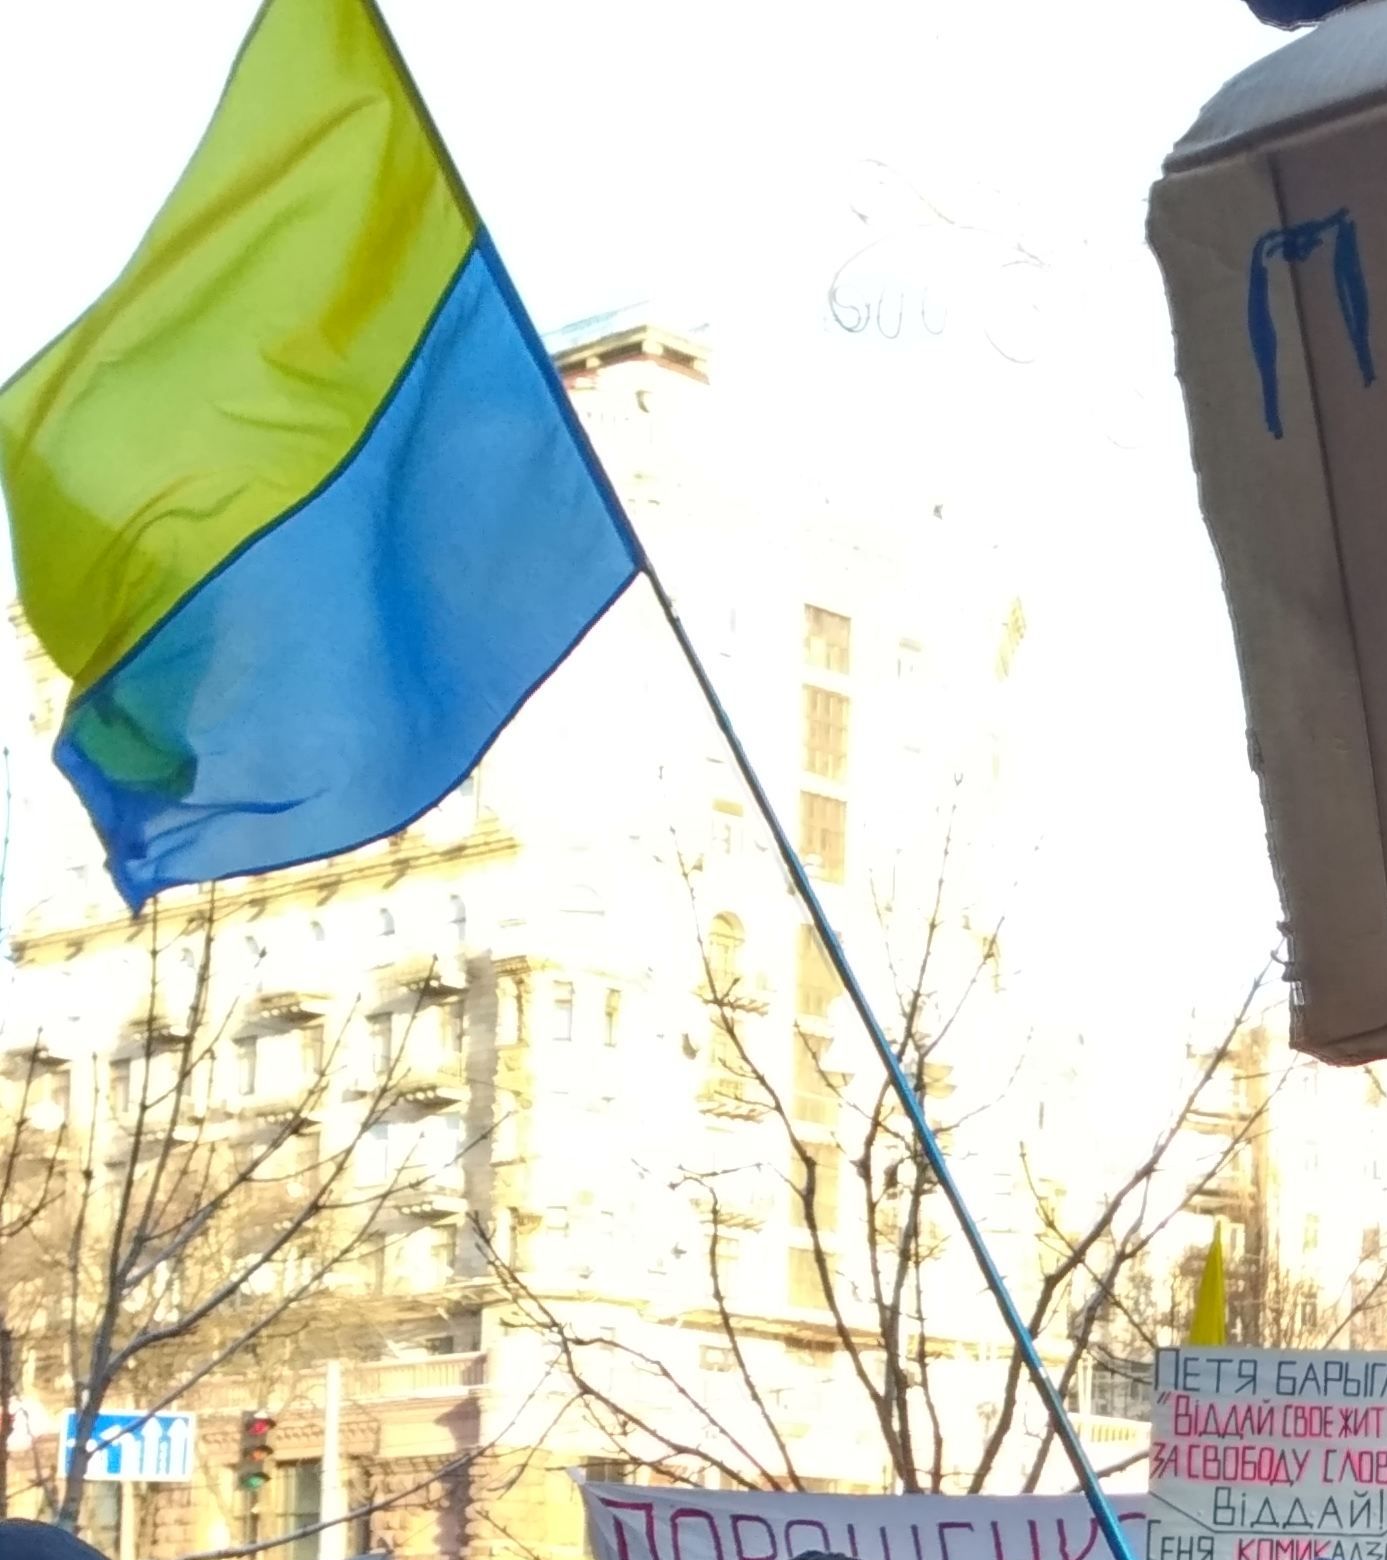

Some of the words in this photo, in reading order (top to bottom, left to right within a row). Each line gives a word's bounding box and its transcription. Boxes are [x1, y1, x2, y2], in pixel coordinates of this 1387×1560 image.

[1154, 1348, 1258, 1395] ПЕТЯ
[1151, 1443, 1178, 1480] ЗА
[1187, 1444, 1311, 1487] СВОБОДУ
